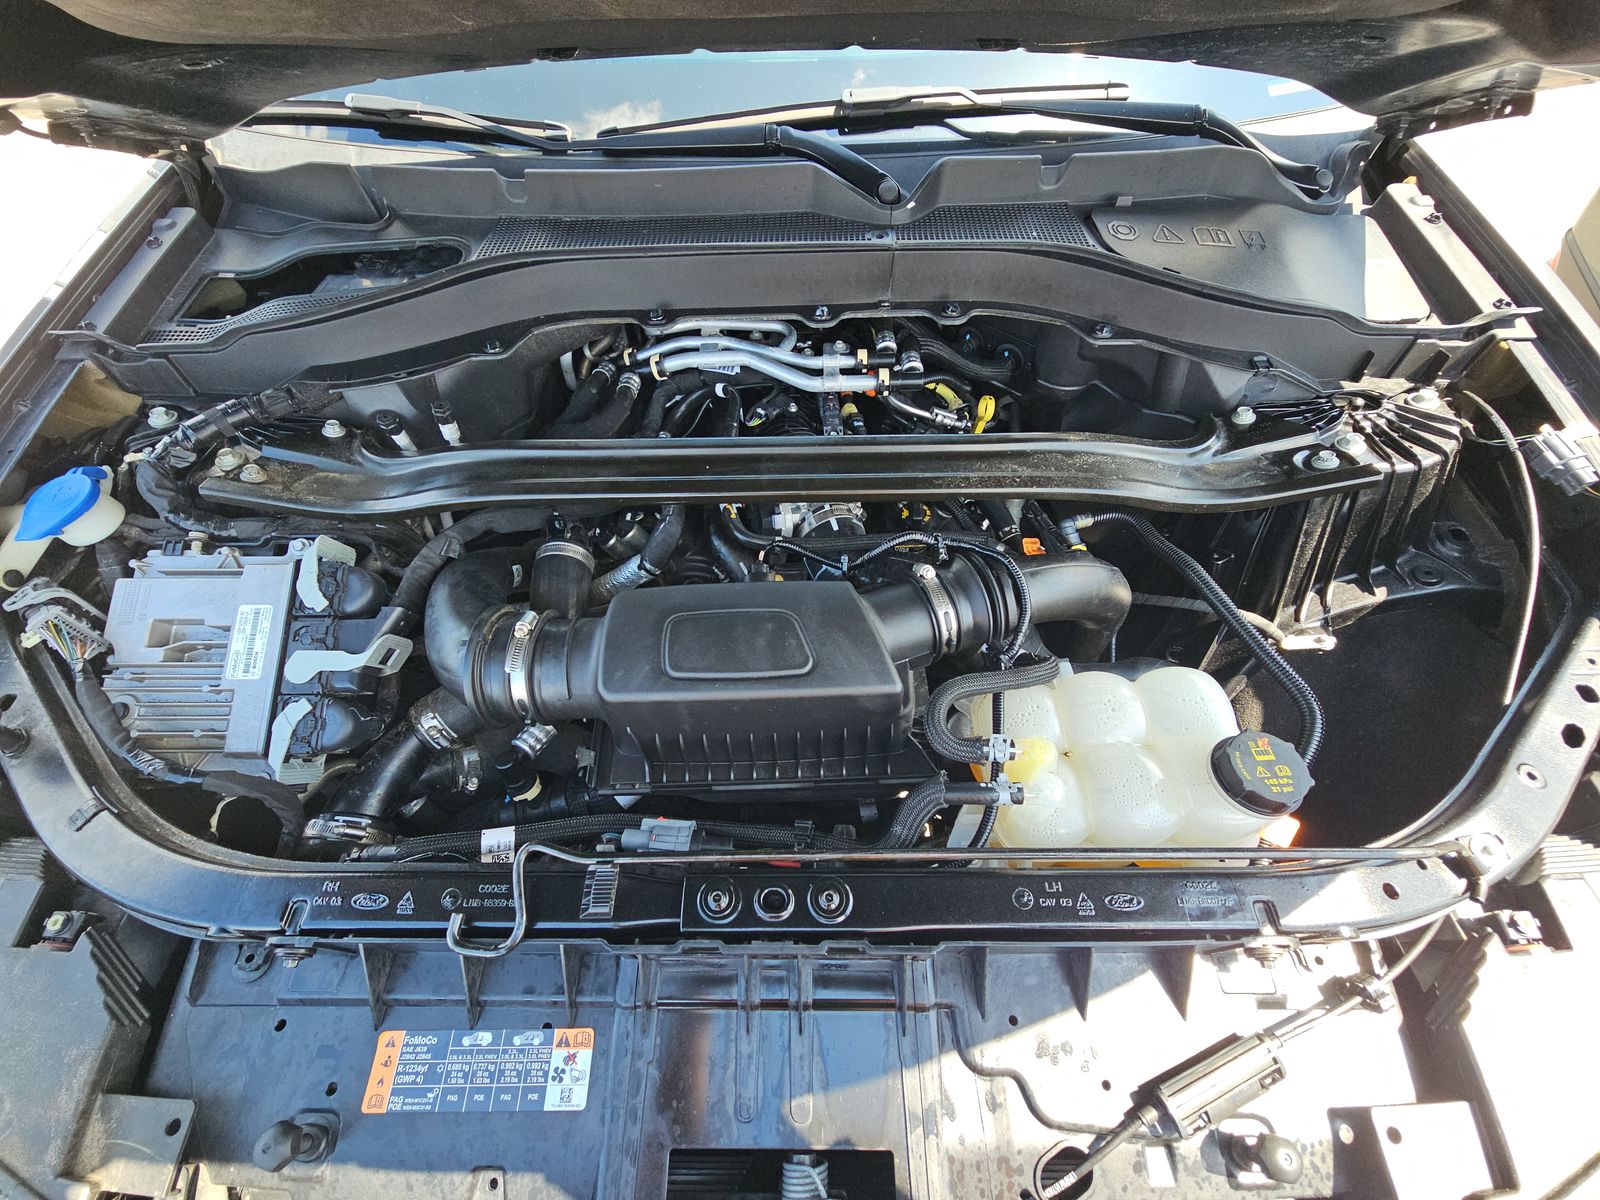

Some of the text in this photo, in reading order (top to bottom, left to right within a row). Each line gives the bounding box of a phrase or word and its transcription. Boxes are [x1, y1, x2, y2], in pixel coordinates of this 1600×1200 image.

[230, 654, 239, 677] FoMoCo
[1271, 785, 1294, 793] 21 psi
[322, 880, 341, 892] RH
[1045, 881, 1062, 892] LH
[312, 896, 343, 906] CAV 03
[353, 893, 387, 909] Ford
[1039, 898, 1072, 906] CAV 03
[1107, 893, 1141, 910] Ford
[404, 1036, 438, 1045] FoMoCo
[397, 1064, 429, 1074] R-1234yf
[463, 1063, 470, 1072] kg
[488, 1063, 495, 1072] kg
[516, 1063, 523, 1071] kg
[542, 1063, 549, 1071] kg
[394, 1075, 424, 1085] (GWP 4)
